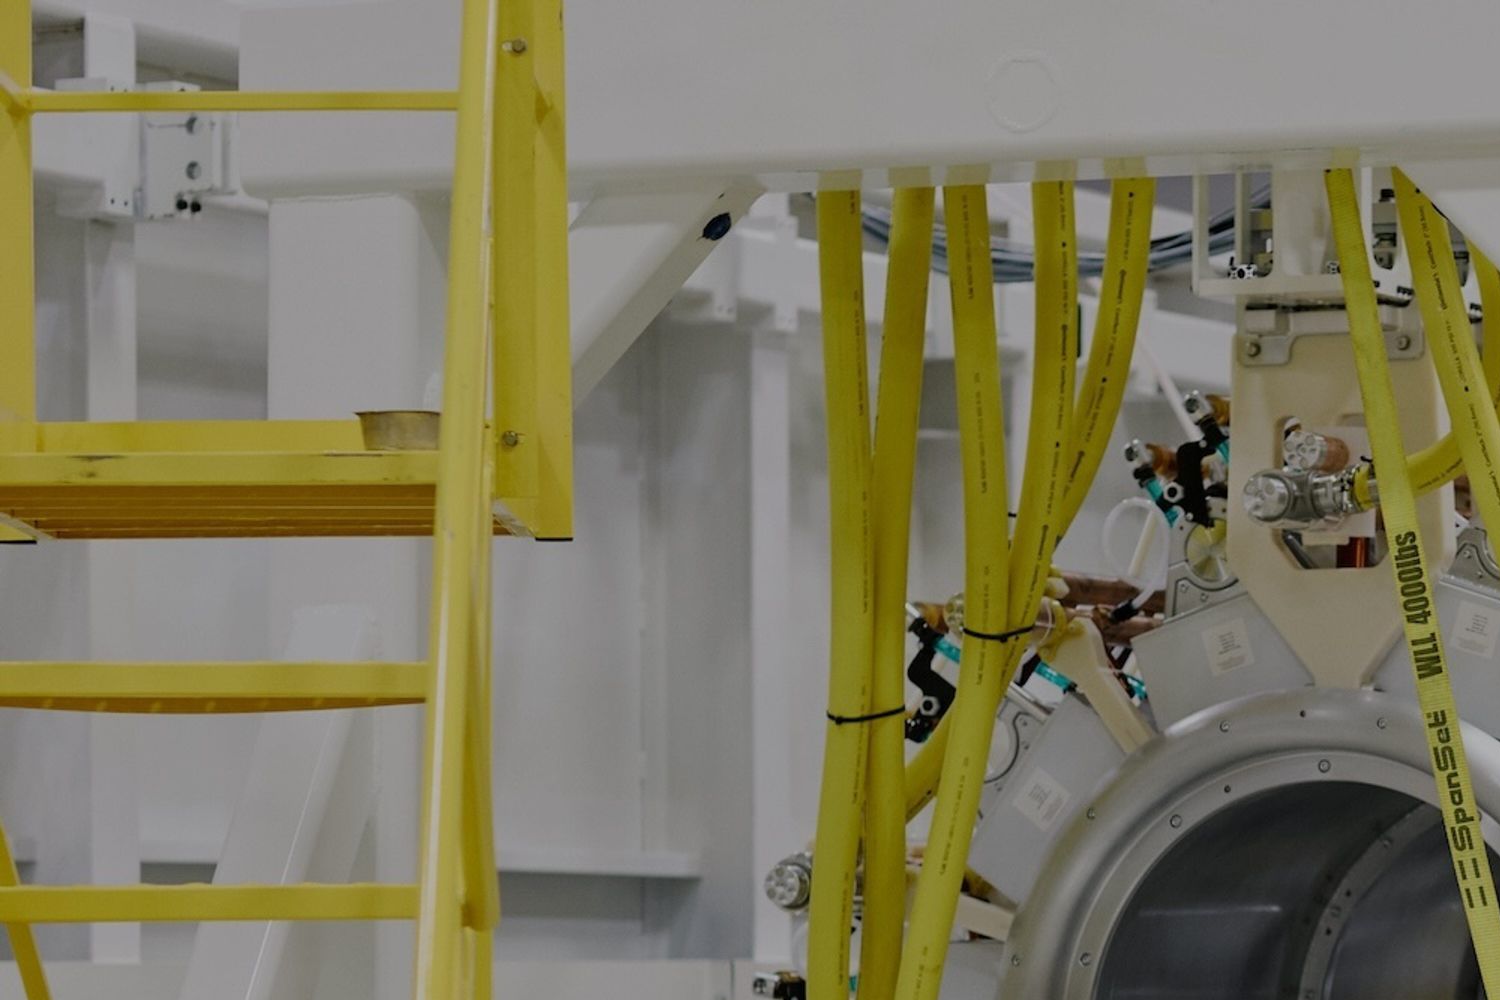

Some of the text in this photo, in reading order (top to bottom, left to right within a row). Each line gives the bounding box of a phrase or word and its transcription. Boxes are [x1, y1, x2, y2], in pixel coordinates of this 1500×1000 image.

[1395, 531, 1474, 852] SpanSet WLL 4000lbs
